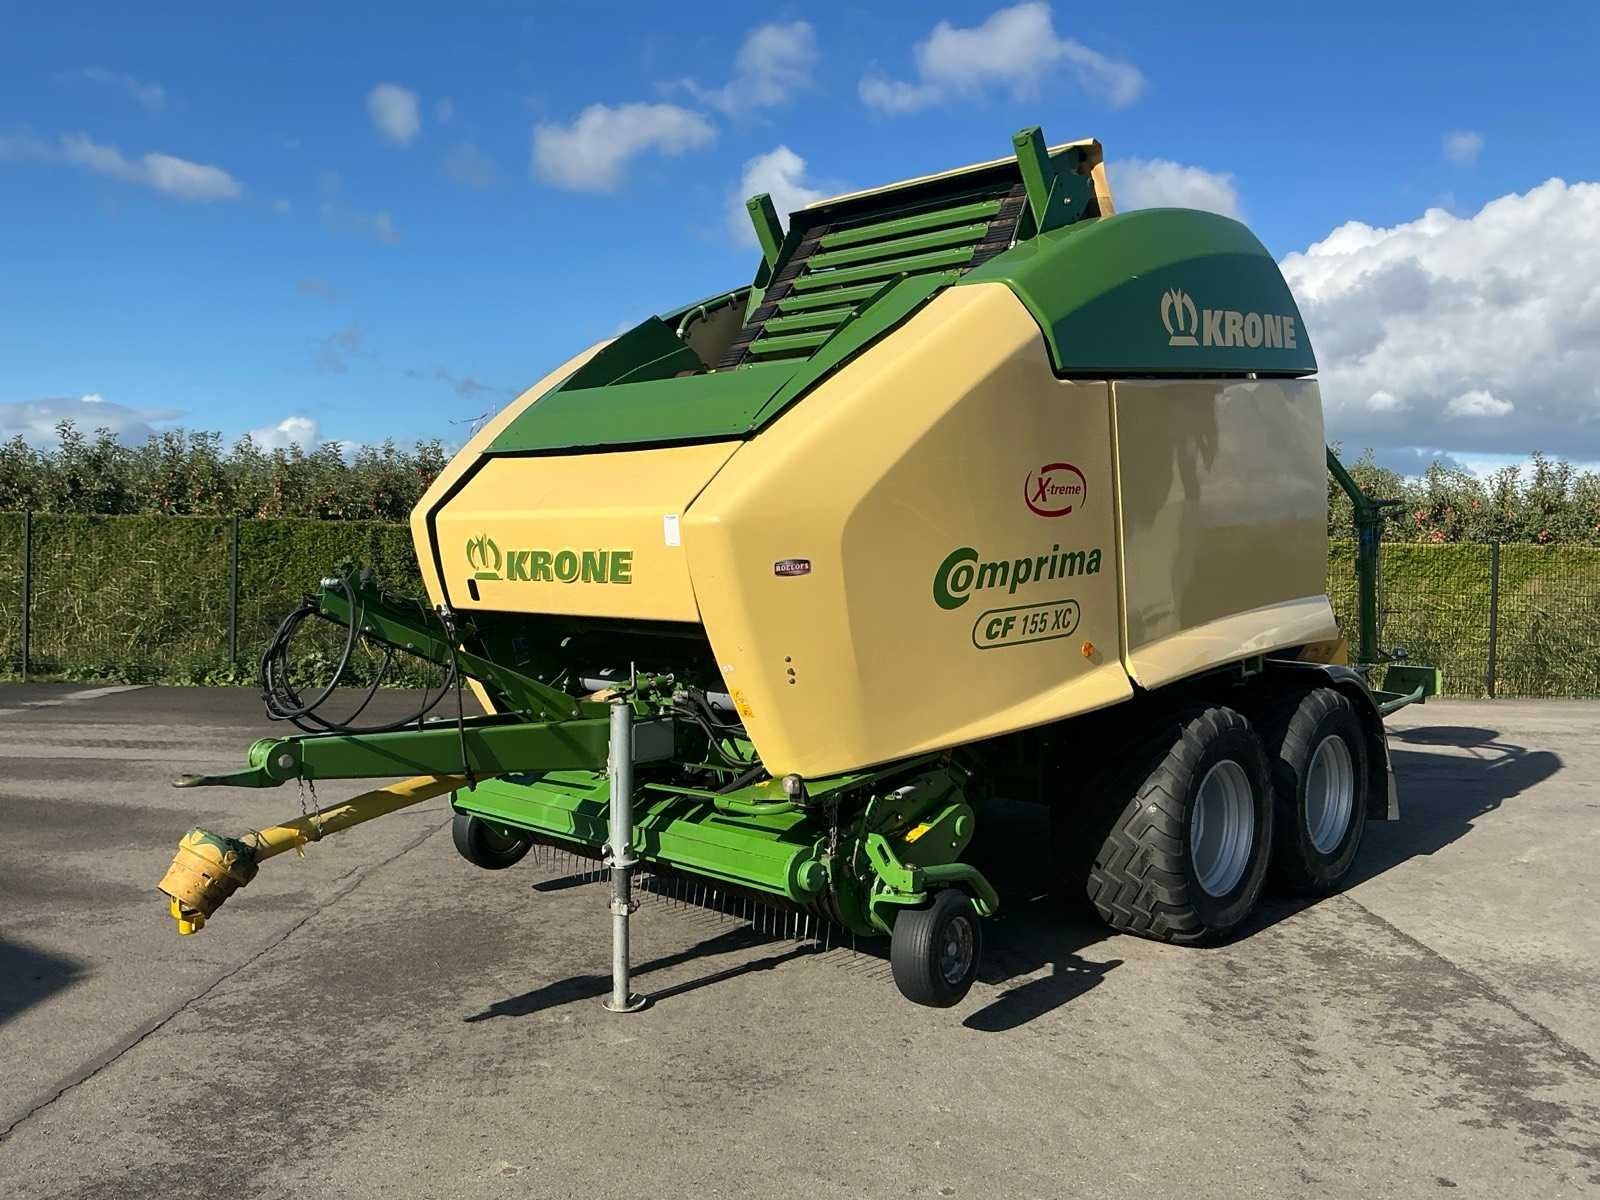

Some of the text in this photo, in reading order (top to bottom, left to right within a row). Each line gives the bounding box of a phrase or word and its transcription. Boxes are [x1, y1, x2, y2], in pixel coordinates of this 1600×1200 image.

[1202, 309, 1298, 349] KRONE
[1031, 477, 1082, 502] X-treme
[506, 549, 633, 584] KRONE
[932, 544, 1102, 610] Comprima
[985, 607, 1073, 641] CF 155 XC
